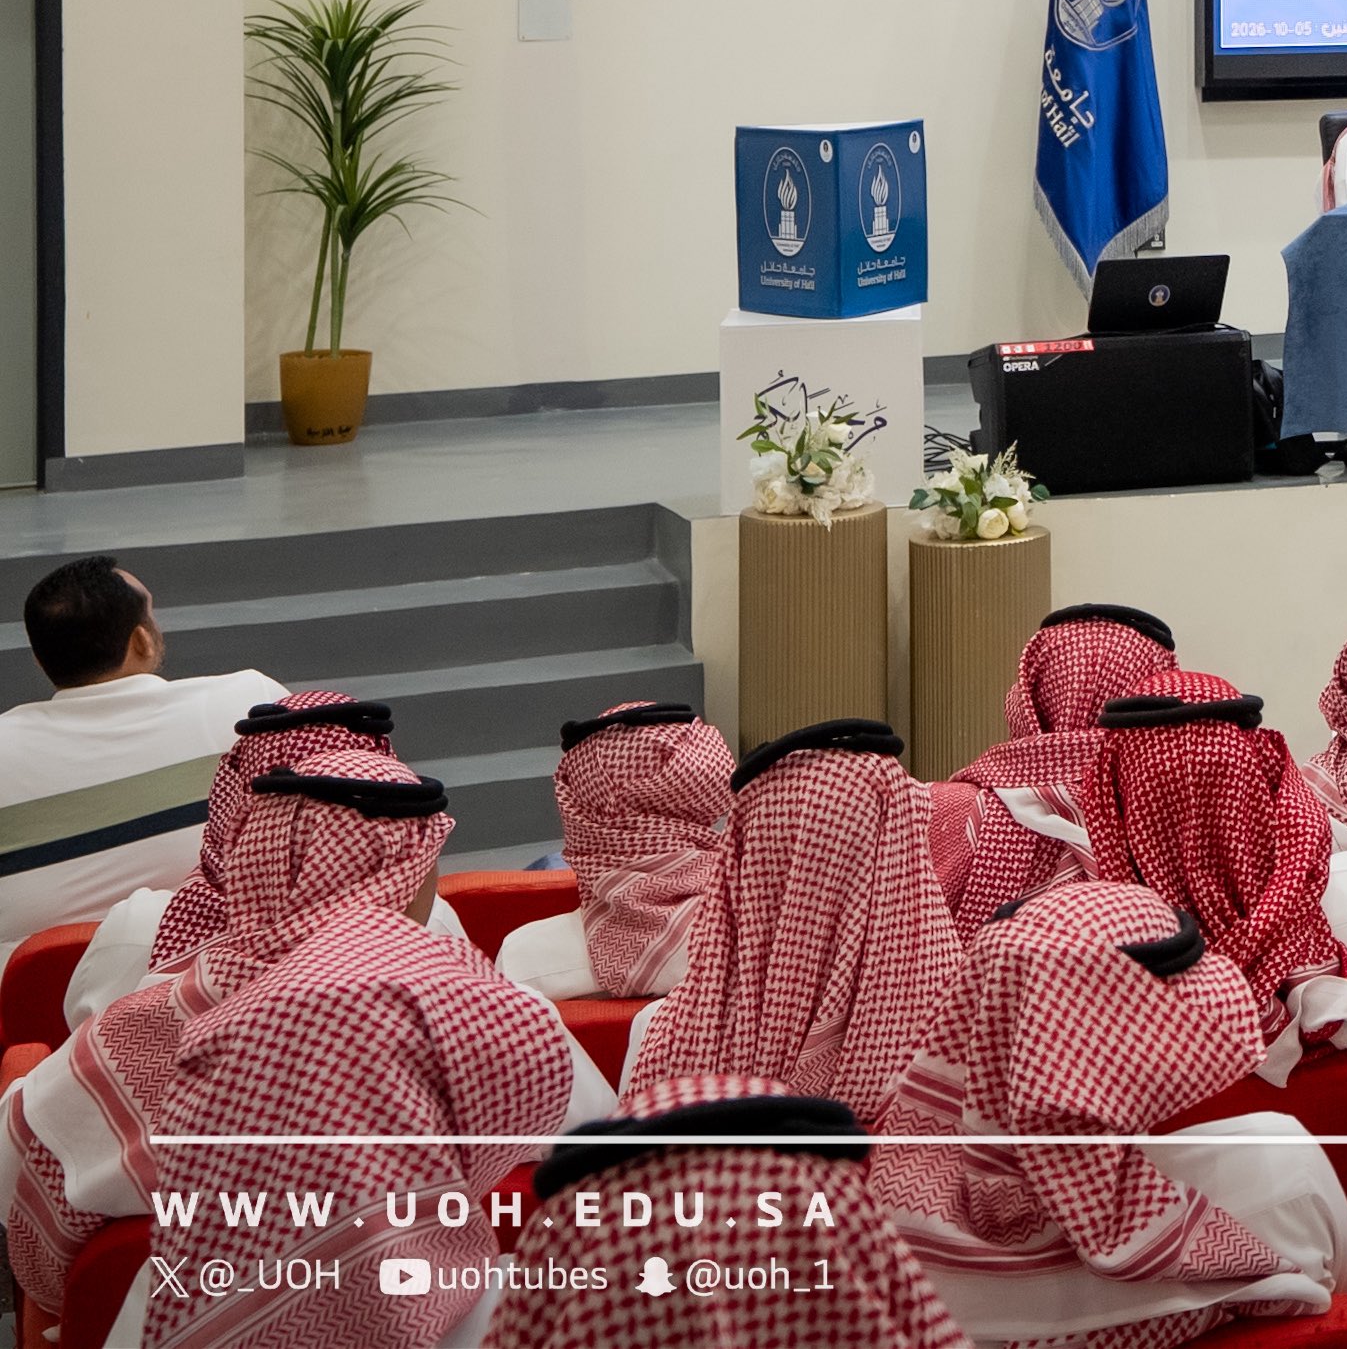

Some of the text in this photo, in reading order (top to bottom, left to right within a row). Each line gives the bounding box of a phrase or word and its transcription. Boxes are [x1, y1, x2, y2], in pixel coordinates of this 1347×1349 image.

[760, 275, 792, 290] University
[857, 274, 887, 288] University
[1002, 360, 1040, 373] OPERA
